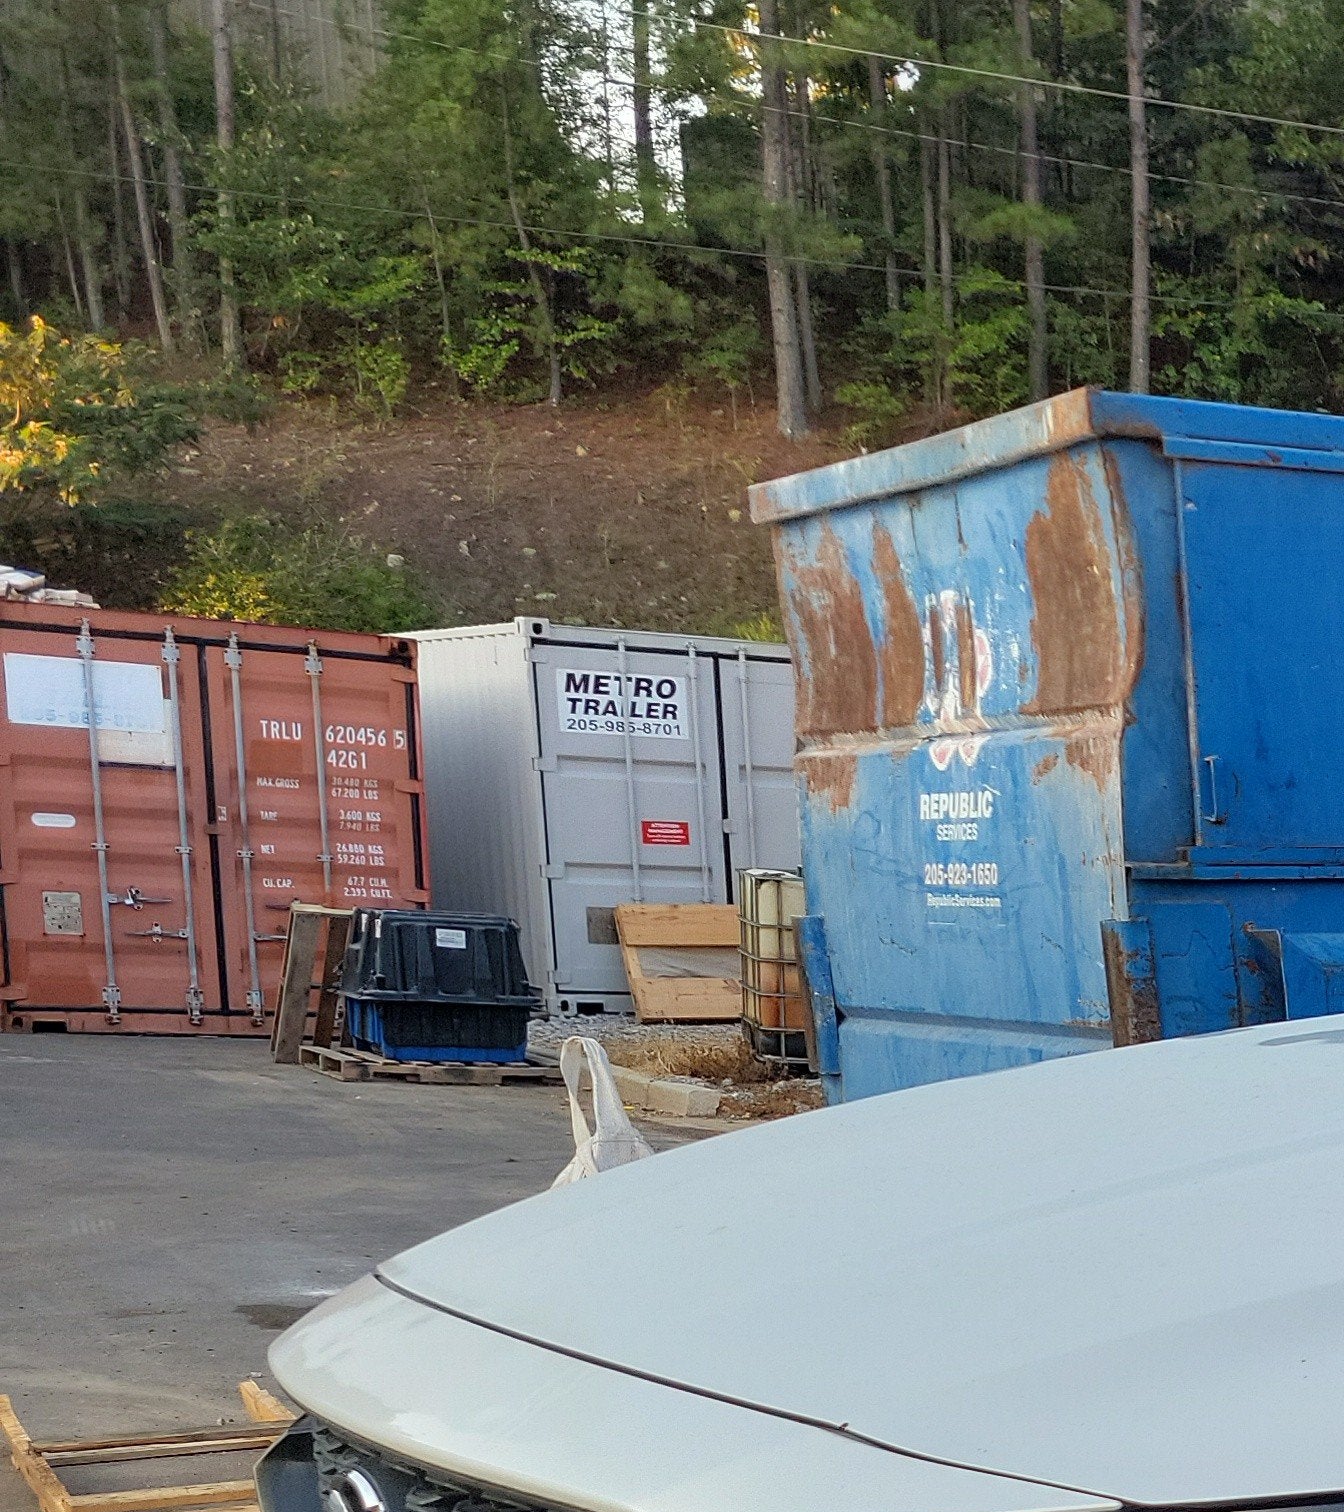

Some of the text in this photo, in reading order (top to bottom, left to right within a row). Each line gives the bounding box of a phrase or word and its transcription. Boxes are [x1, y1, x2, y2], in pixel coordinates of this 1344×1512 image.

[565, 672, 677, 699] METRO
[260, 720, 302, 741] TRLU
[325, 725, 387, 747] 620456
[566, 718, 681, 736] 205-985-8701
[327, 750, 367, 769] 42G1
[920, 790, 993, 820] REPUBLIC
[936, 823, 978, 841] SERVICES
[924, 863, 998, 885] 205-923-1650
